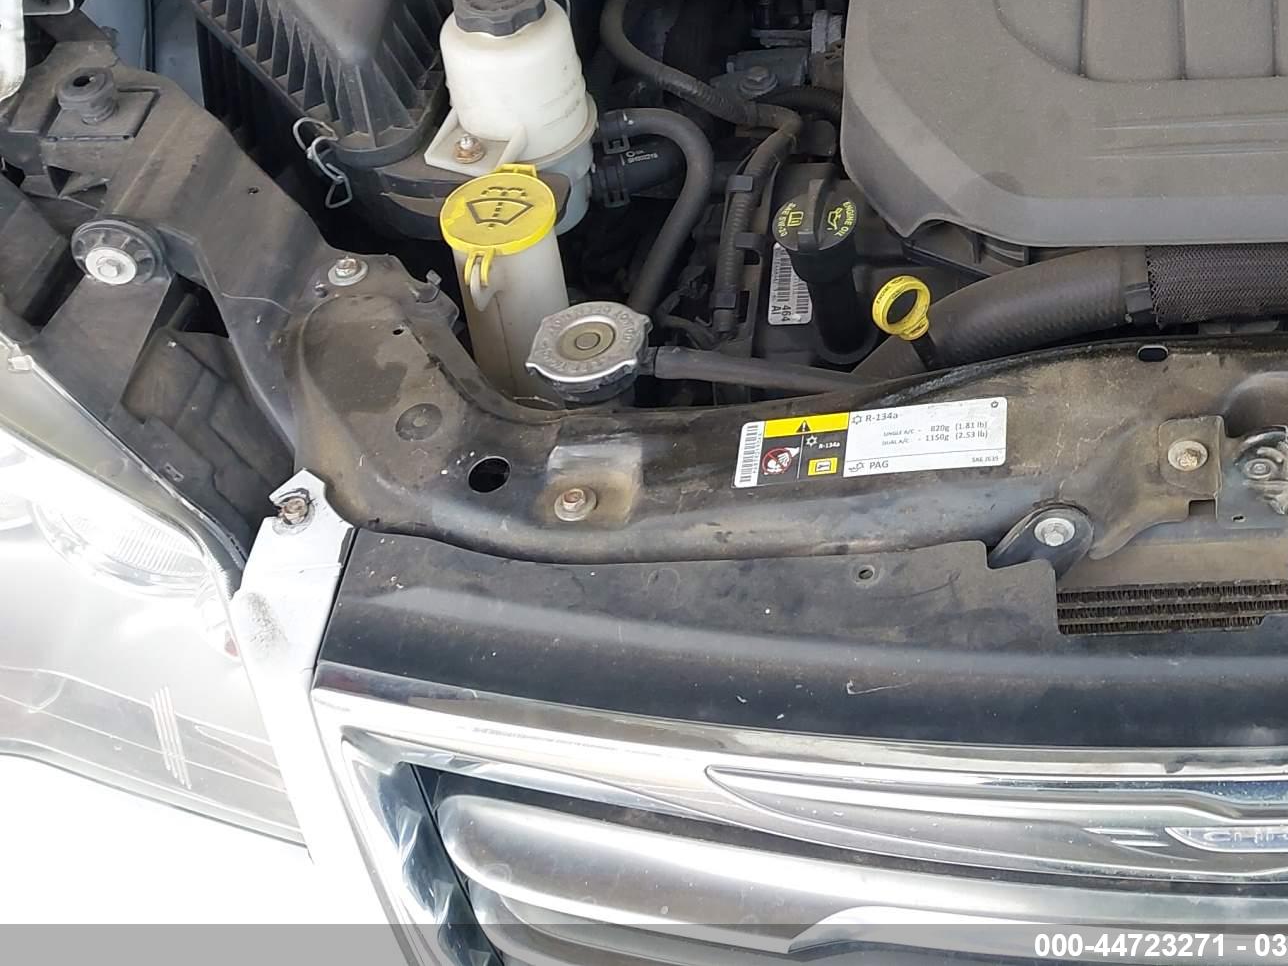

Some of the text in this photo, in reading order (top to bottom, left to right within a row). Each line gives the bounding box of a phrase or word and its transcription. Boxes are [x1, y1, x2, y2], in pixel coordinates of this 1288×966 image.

[782, 201, 797, 216] SAE
[834, 201, 855, 237] ENGINE OIL
[781, 304, 792, 322] 464
[865, 411, 899, 423] R-134a
[930, 424, 950, 433] 820g
[955, 422, 976, 431] (1.81
[976, 421, 988, 430] lb)
[925, 433, 950, 442] 1150g
[955, 430, 976, 439] (2.53
[977, 429, 988, 438] lb)
[818, 441, 841, 450] R-134a
[869, 460, 889, 469] PAG
